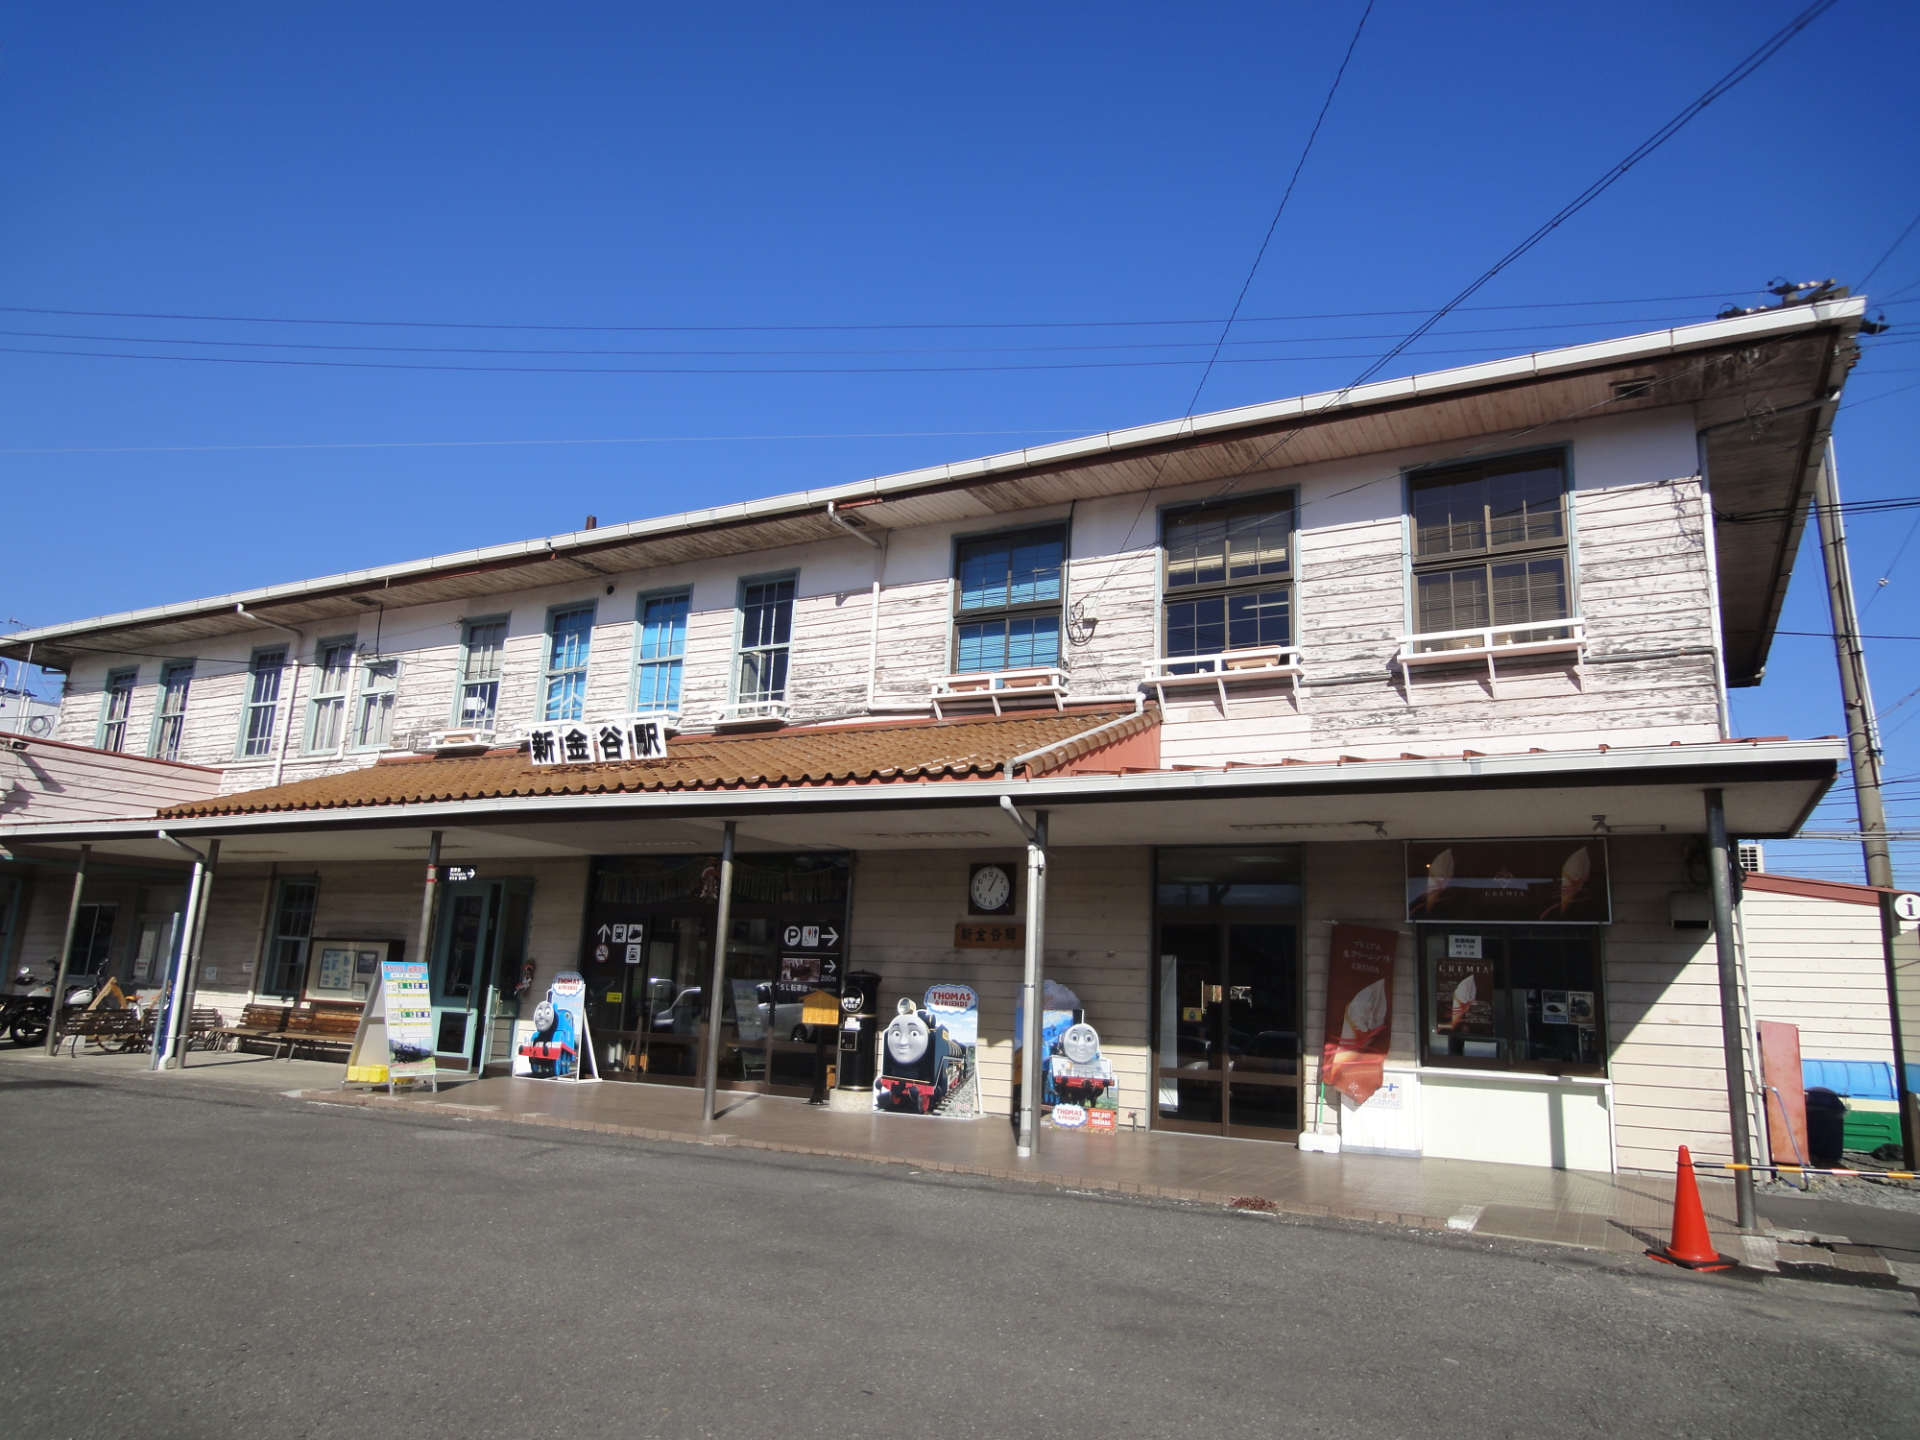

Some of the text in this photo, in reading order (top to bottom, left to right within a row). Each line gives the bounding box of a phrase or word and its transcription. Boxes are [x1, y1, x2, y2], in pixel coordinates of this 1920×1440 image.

[531, 722, 662, 763] 新金谷駅
[1342, 949, 1391, 963] 生クリームソフト
[1351, 962, 1380, 974] CREMIA
[1438, 964, 1489, 974] CREMIA
[557, 977, 580, 985] THOMAS
[820, 974, 837, 982] 200m
[932, 992, 971, 1001] THOMAS
[1056, 1108, 1083, 1117] THOMAS
